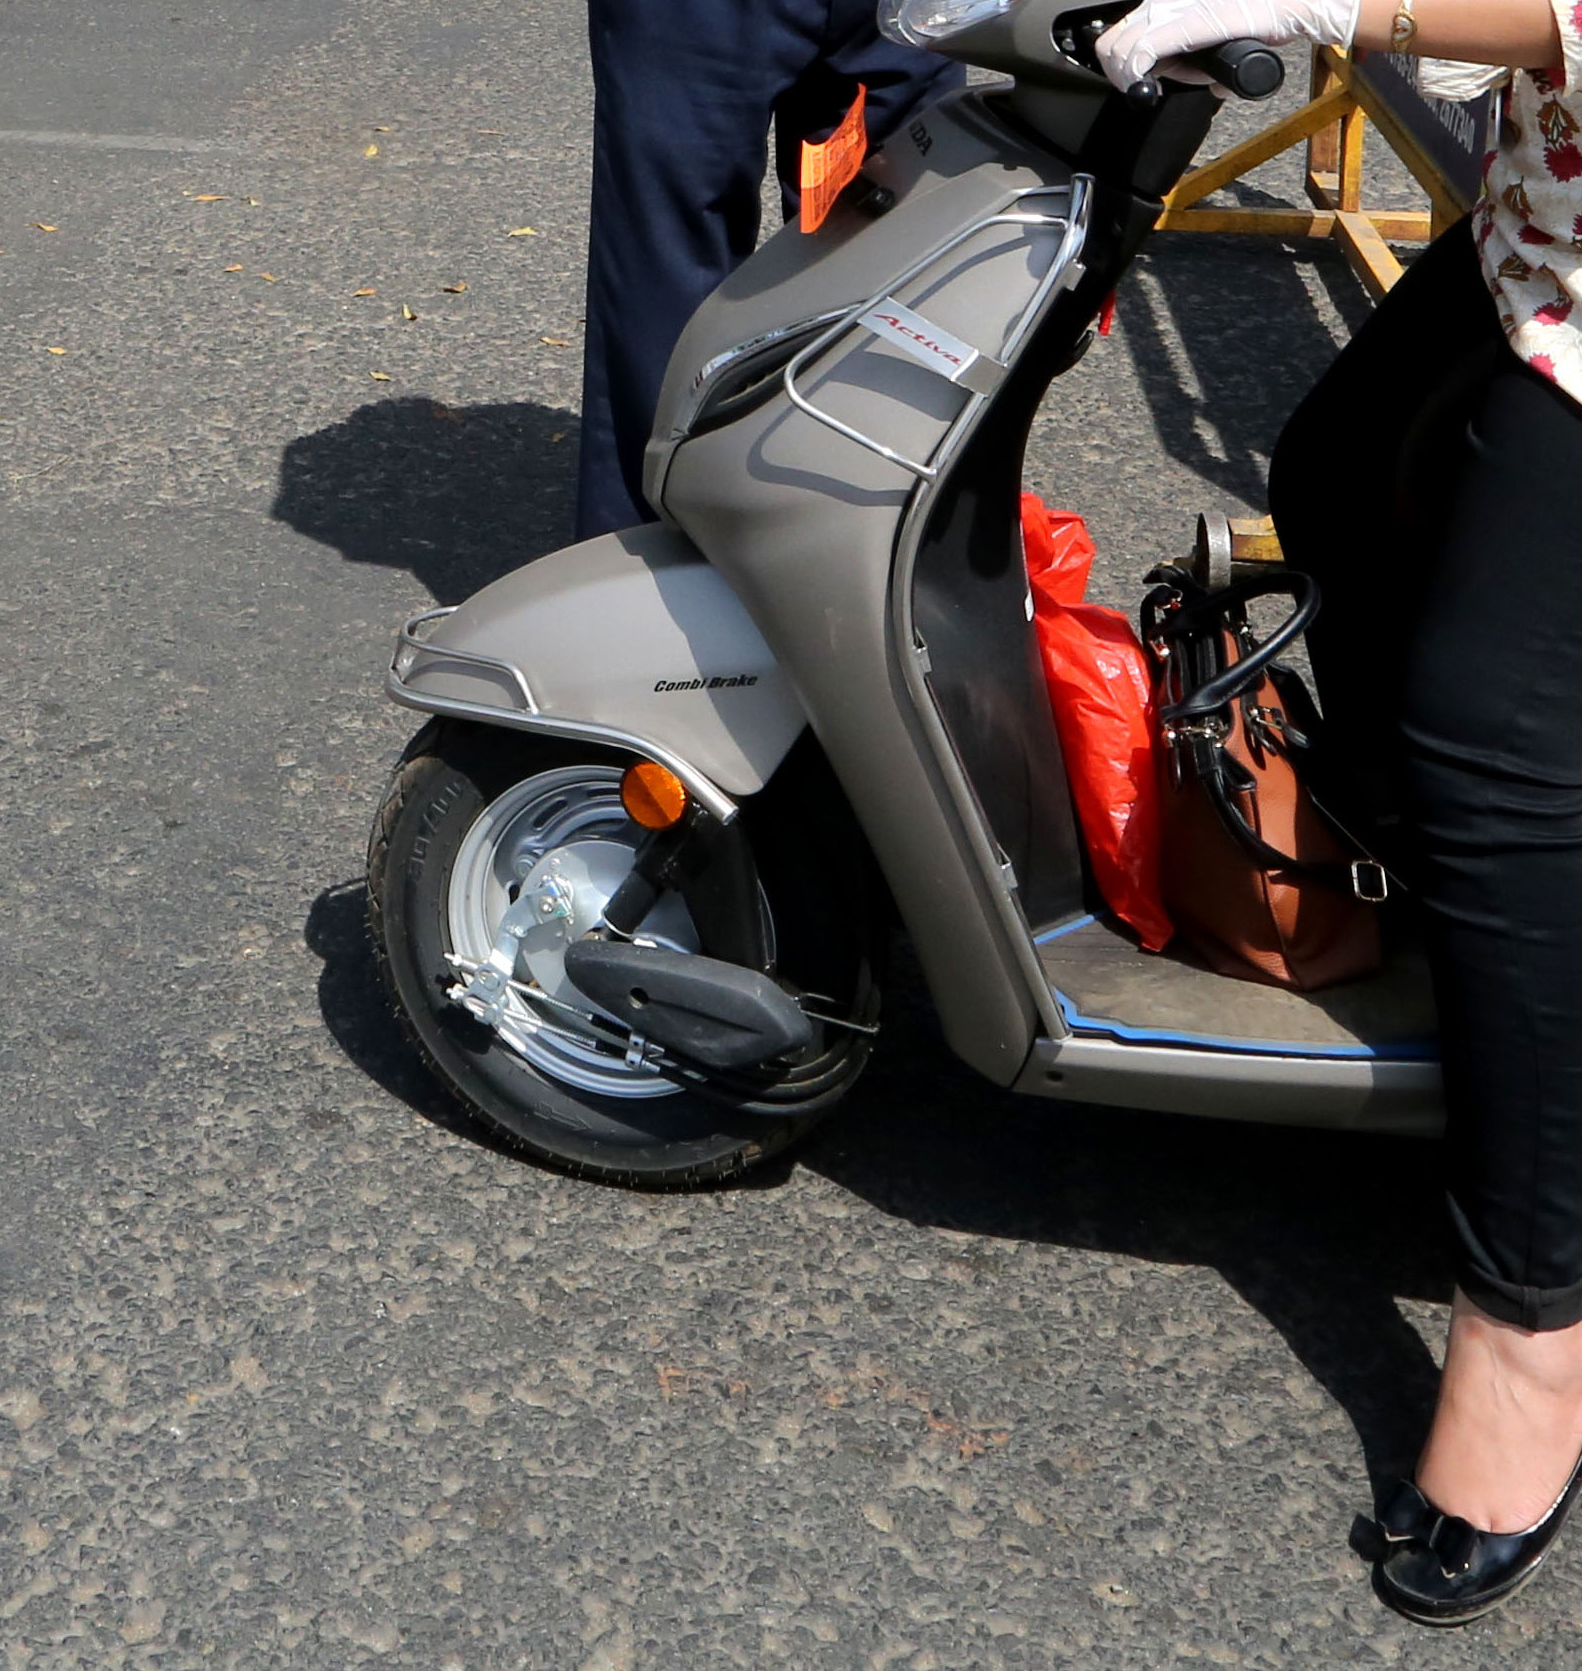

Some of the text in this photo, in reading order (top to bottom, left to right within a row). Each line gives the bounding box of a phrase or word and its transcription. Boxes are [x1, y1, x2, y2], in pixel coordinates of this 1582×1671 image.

[874, 313, 961, 364] Activa
[654, 674, 758, 692] Combi Brake
